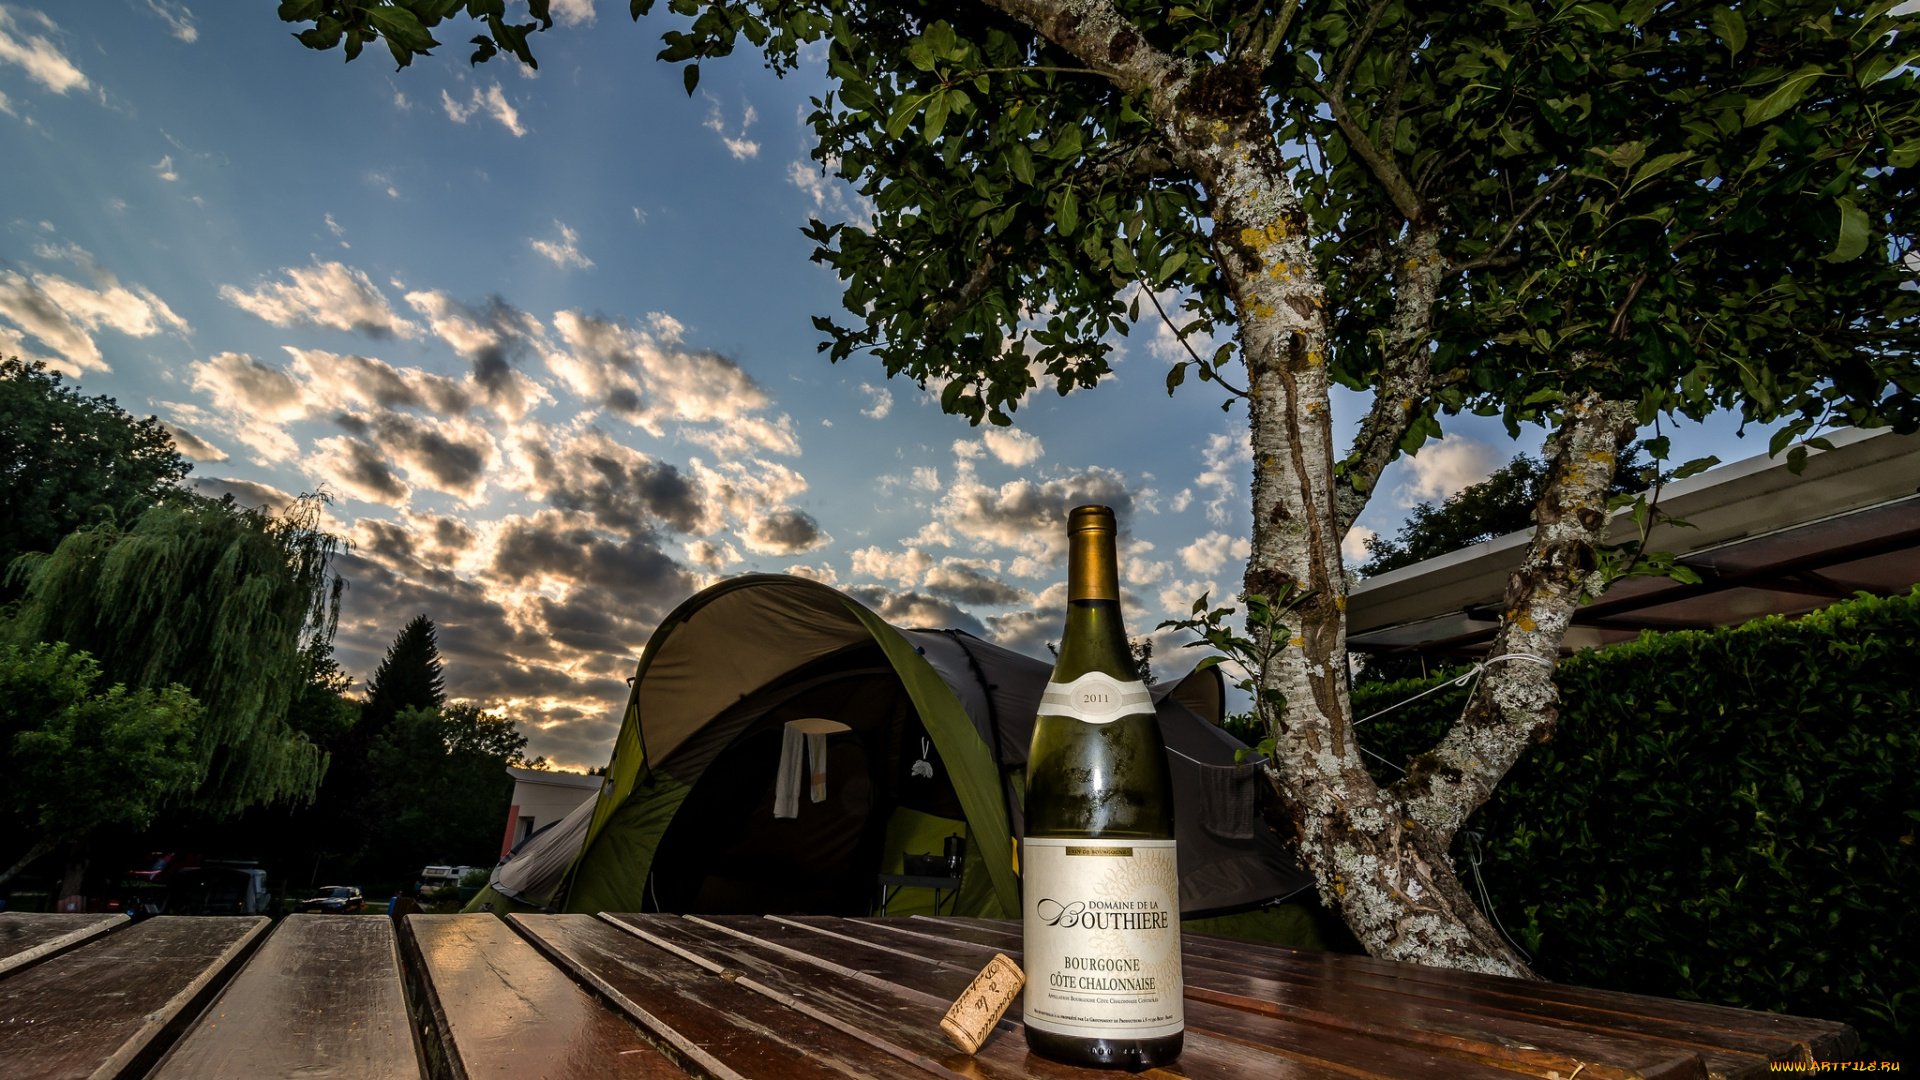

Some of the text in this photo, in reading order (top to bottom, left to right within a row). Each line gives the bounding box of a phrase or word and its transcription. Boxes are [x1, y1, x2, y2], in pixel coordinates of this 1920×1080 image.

[1083, 694, 1109, 703] 2011
[1088, 900, 1159, 910] DOMAINE DE LA
[1037, 898, 1169, 930] BOUTHIERE
[1064, 956, 1140, 972] BOURGOGNE
[1050, 971, 1156, 991] CÔTE CHALONNAISE
